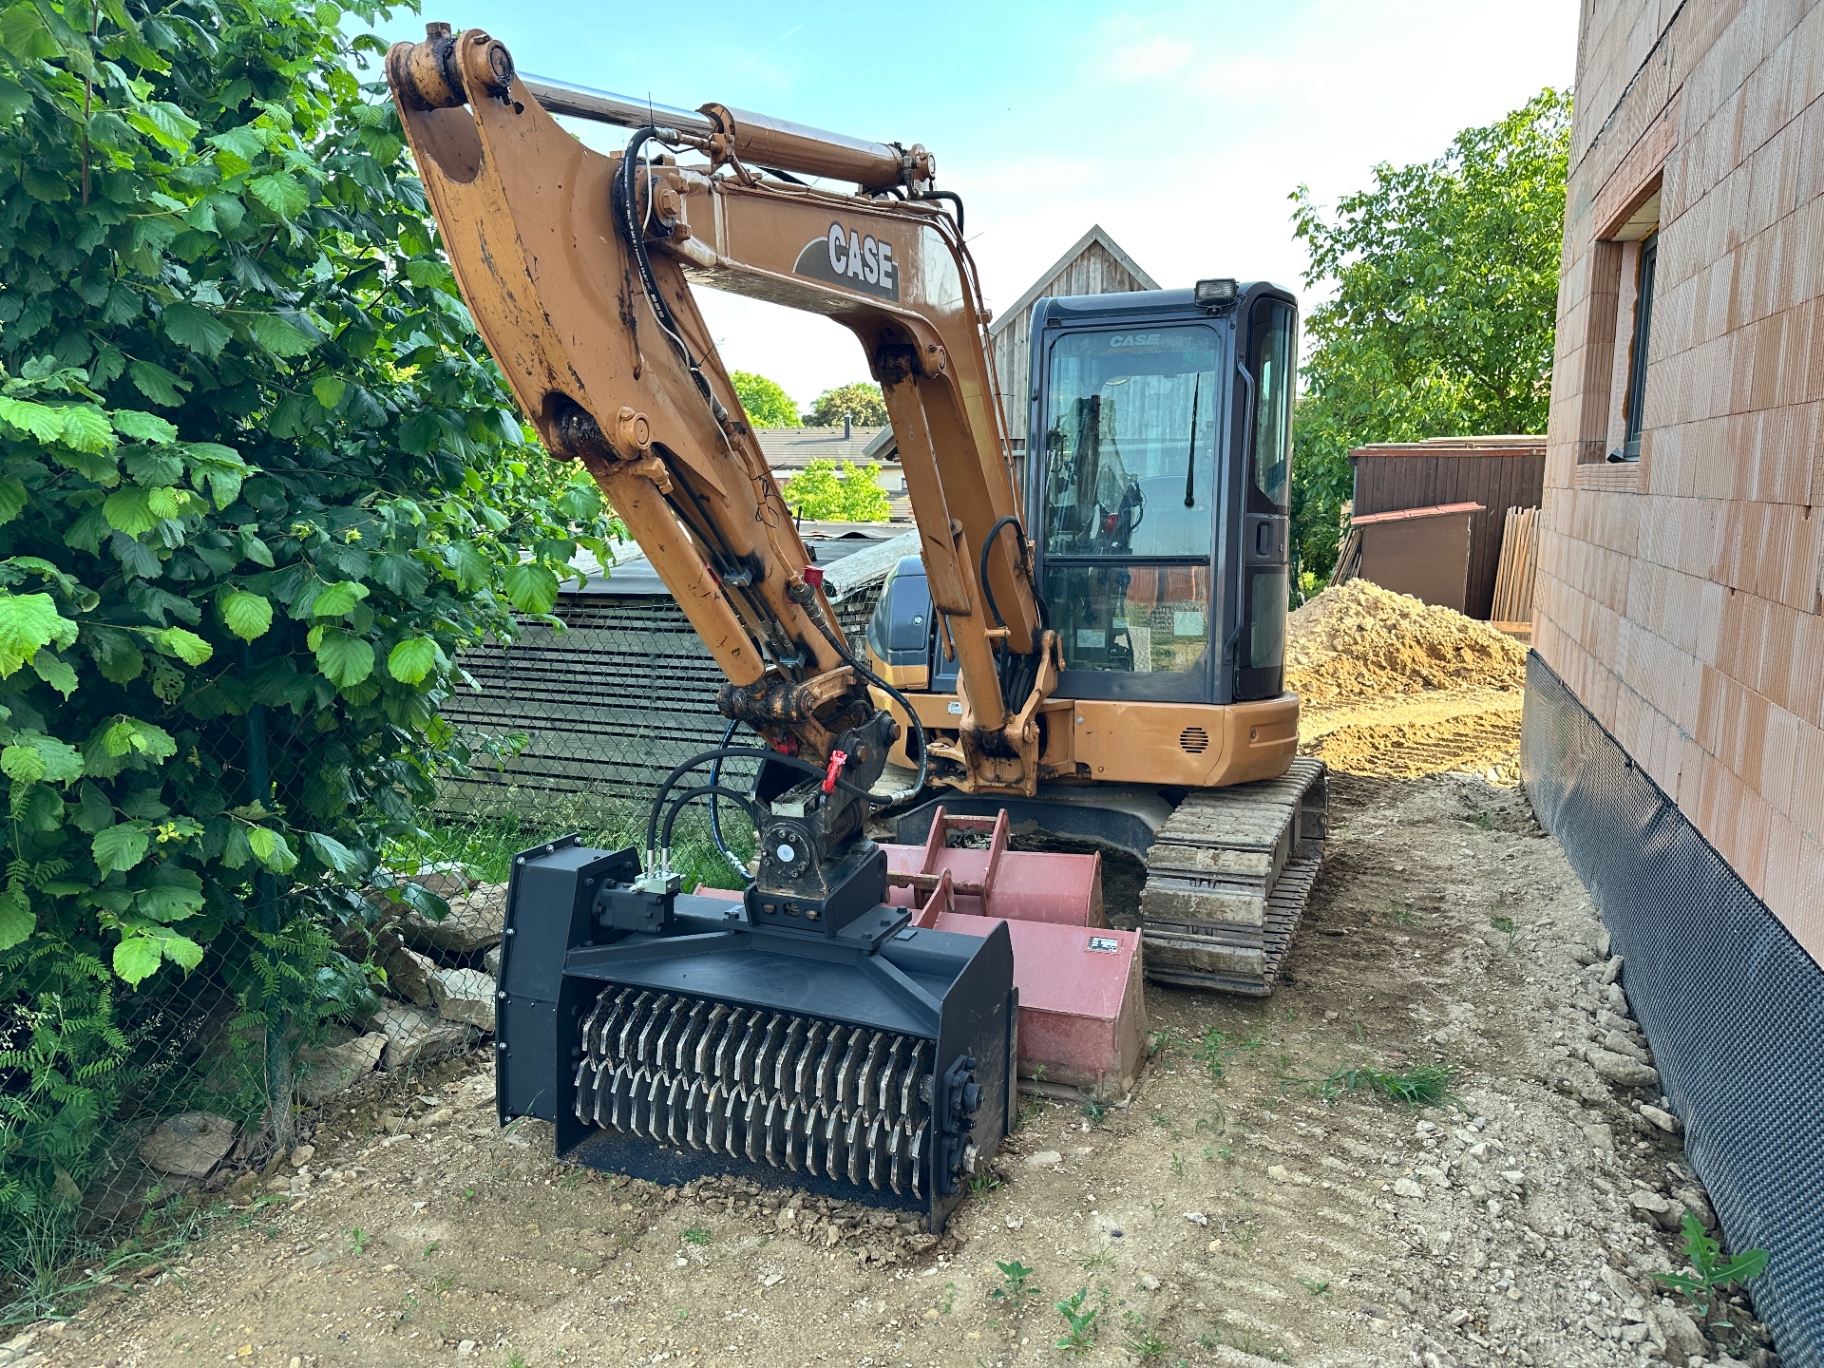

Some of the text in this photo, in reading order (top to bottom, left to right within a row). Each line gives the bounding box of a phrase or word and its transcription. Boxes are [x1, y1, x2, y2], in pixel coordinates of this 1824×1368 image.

[828, 222, 893, 290] CASE
[1110, 334, 1160, 347] CASE
[1610, 353, 1627, 449] USTROTHERM
